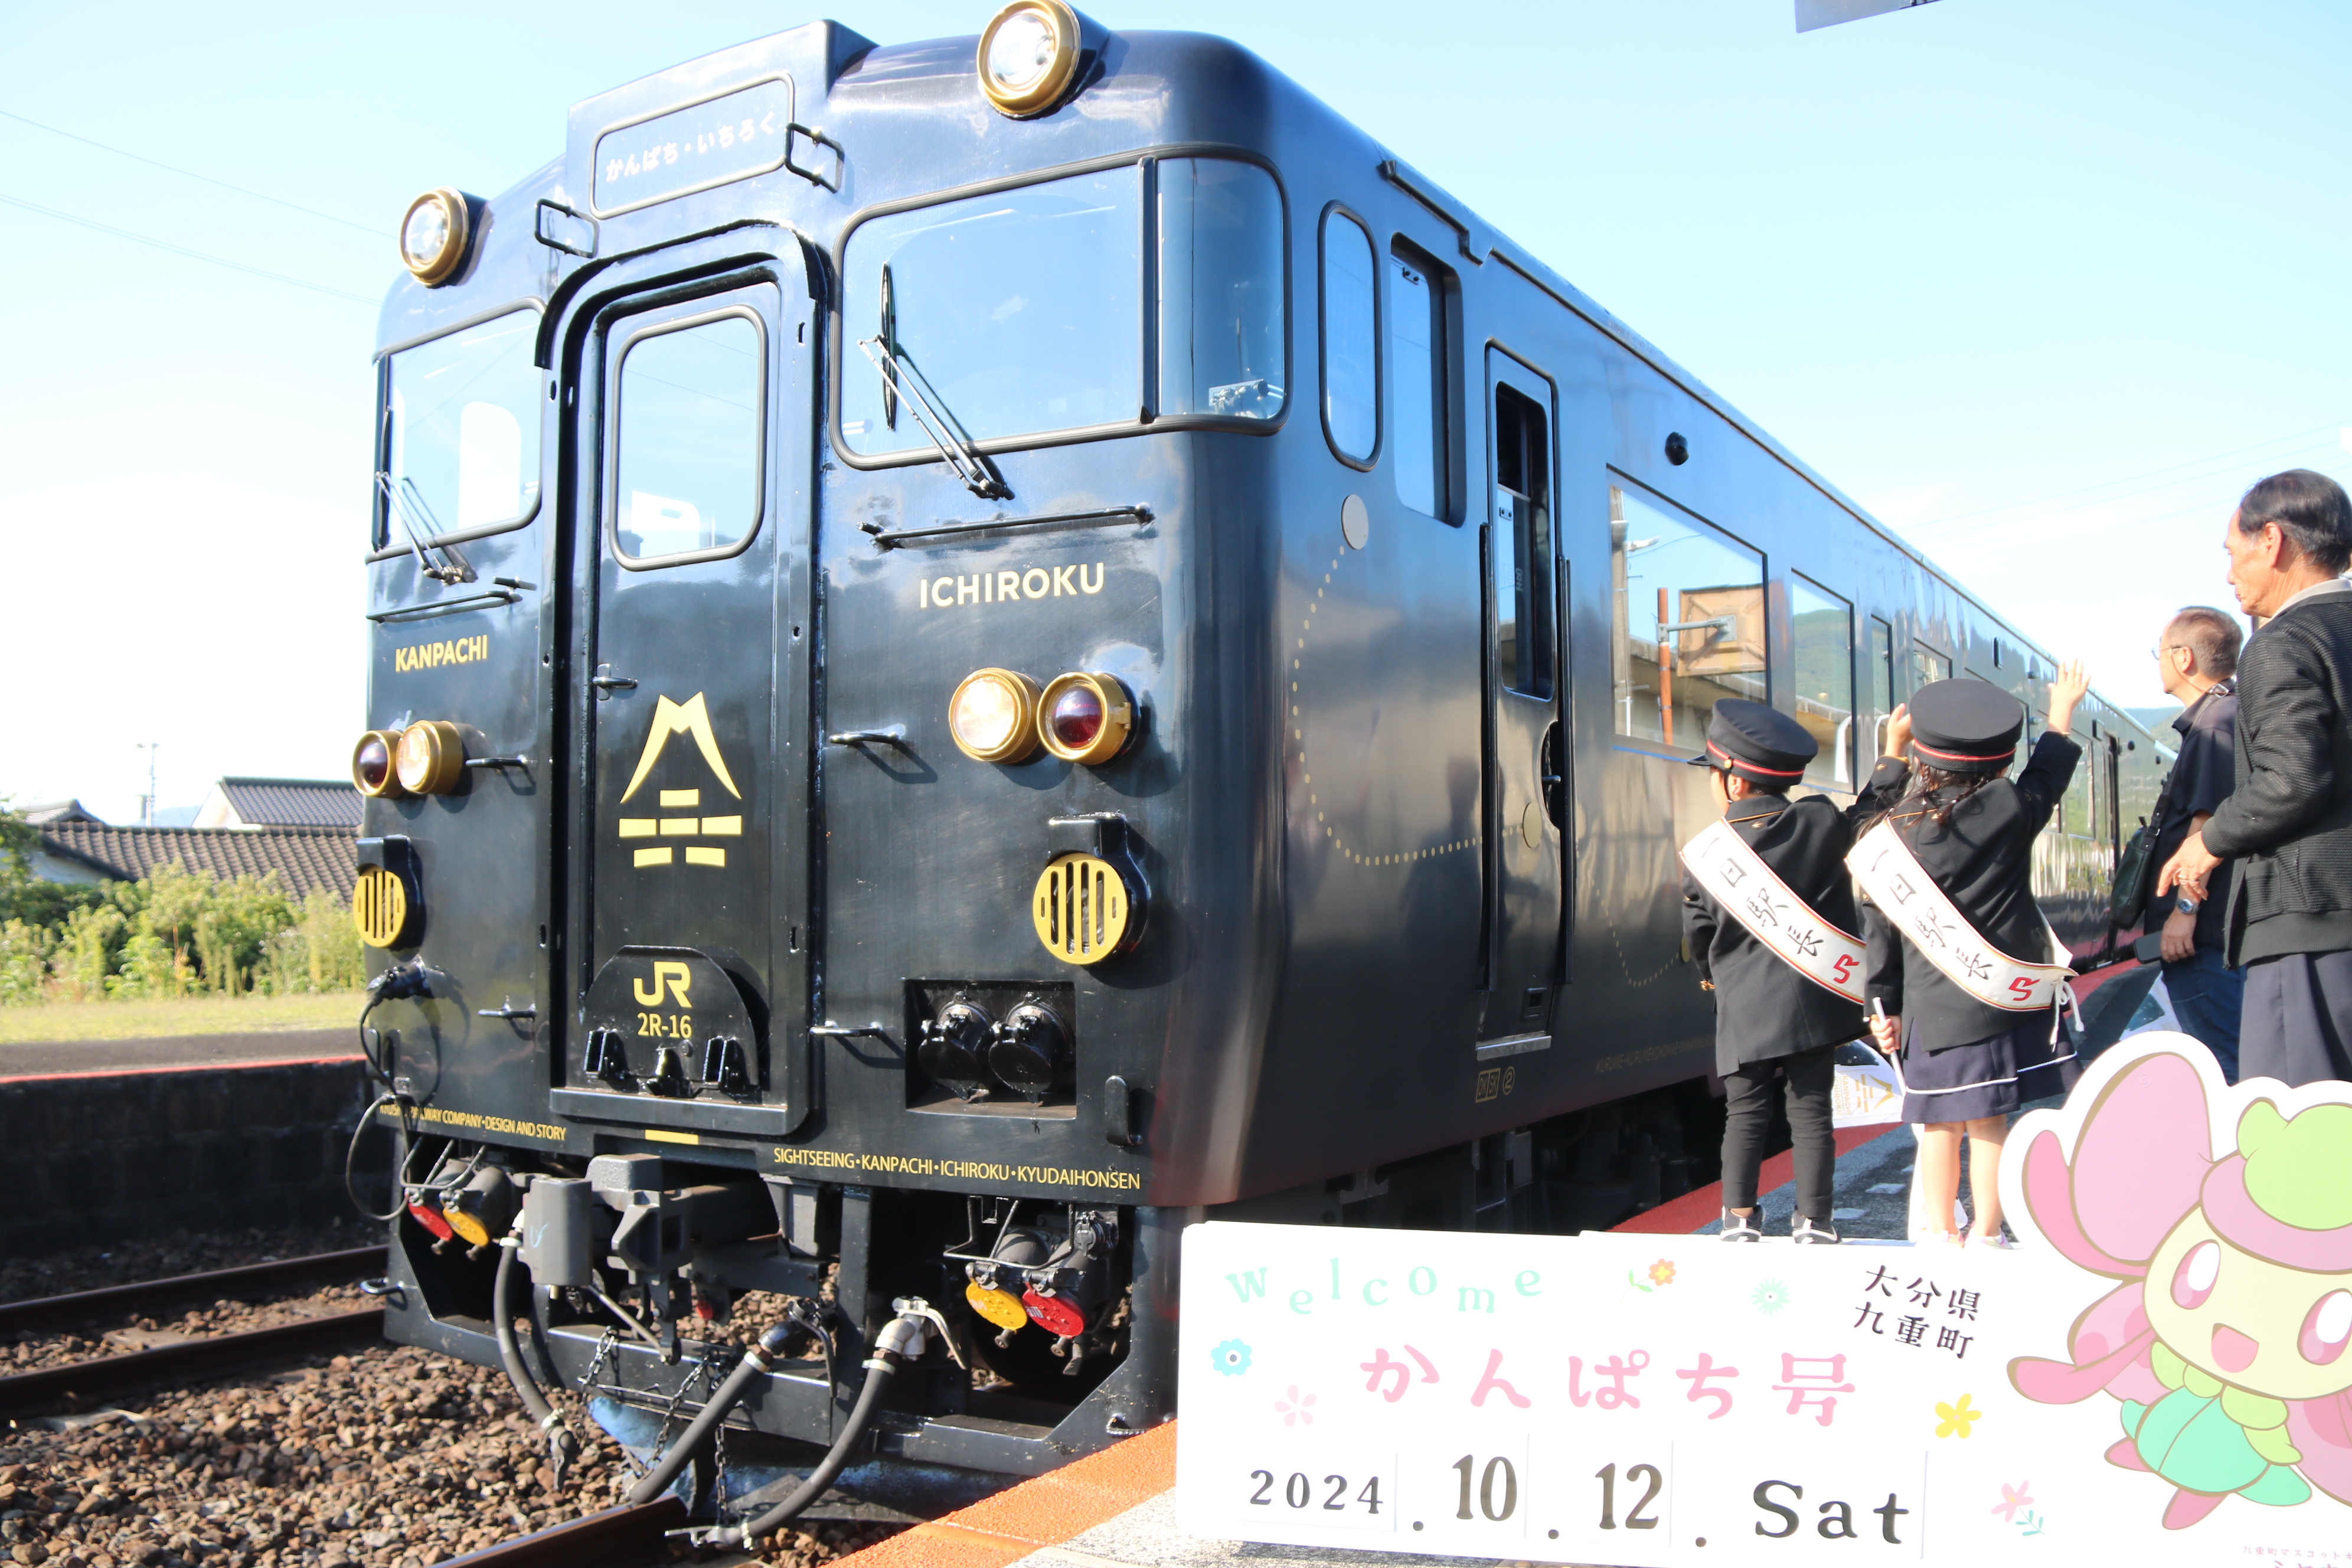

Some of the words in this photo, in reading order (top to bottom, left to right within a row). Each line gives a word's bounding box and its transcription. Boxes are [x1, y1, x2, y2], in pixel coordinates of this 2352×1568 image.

[920, 562, 1104, 608] ICHIROKU
[395, 634, 488, 672] KANPACHI
[633, 961, 693, 1008] JR
[1833, 953, 1861, 984] JR
[2008, 976, 2041, 1002] JR
[636, 1012, 692, 1039] 2R-16
[1842, 1075, 1852, 1115] KANPACHI
[515, 1121, 536, 1137] AND
[536, 1123, 567, 1141] STORY
[1864, 1265, 1981, 1321] 大分県
[1853, 1301, 1975, 1359] 九重町
[1360, 1344, 1856, 1427] かんぱち号
[1753, 1479, 1910, 1544] Sat
